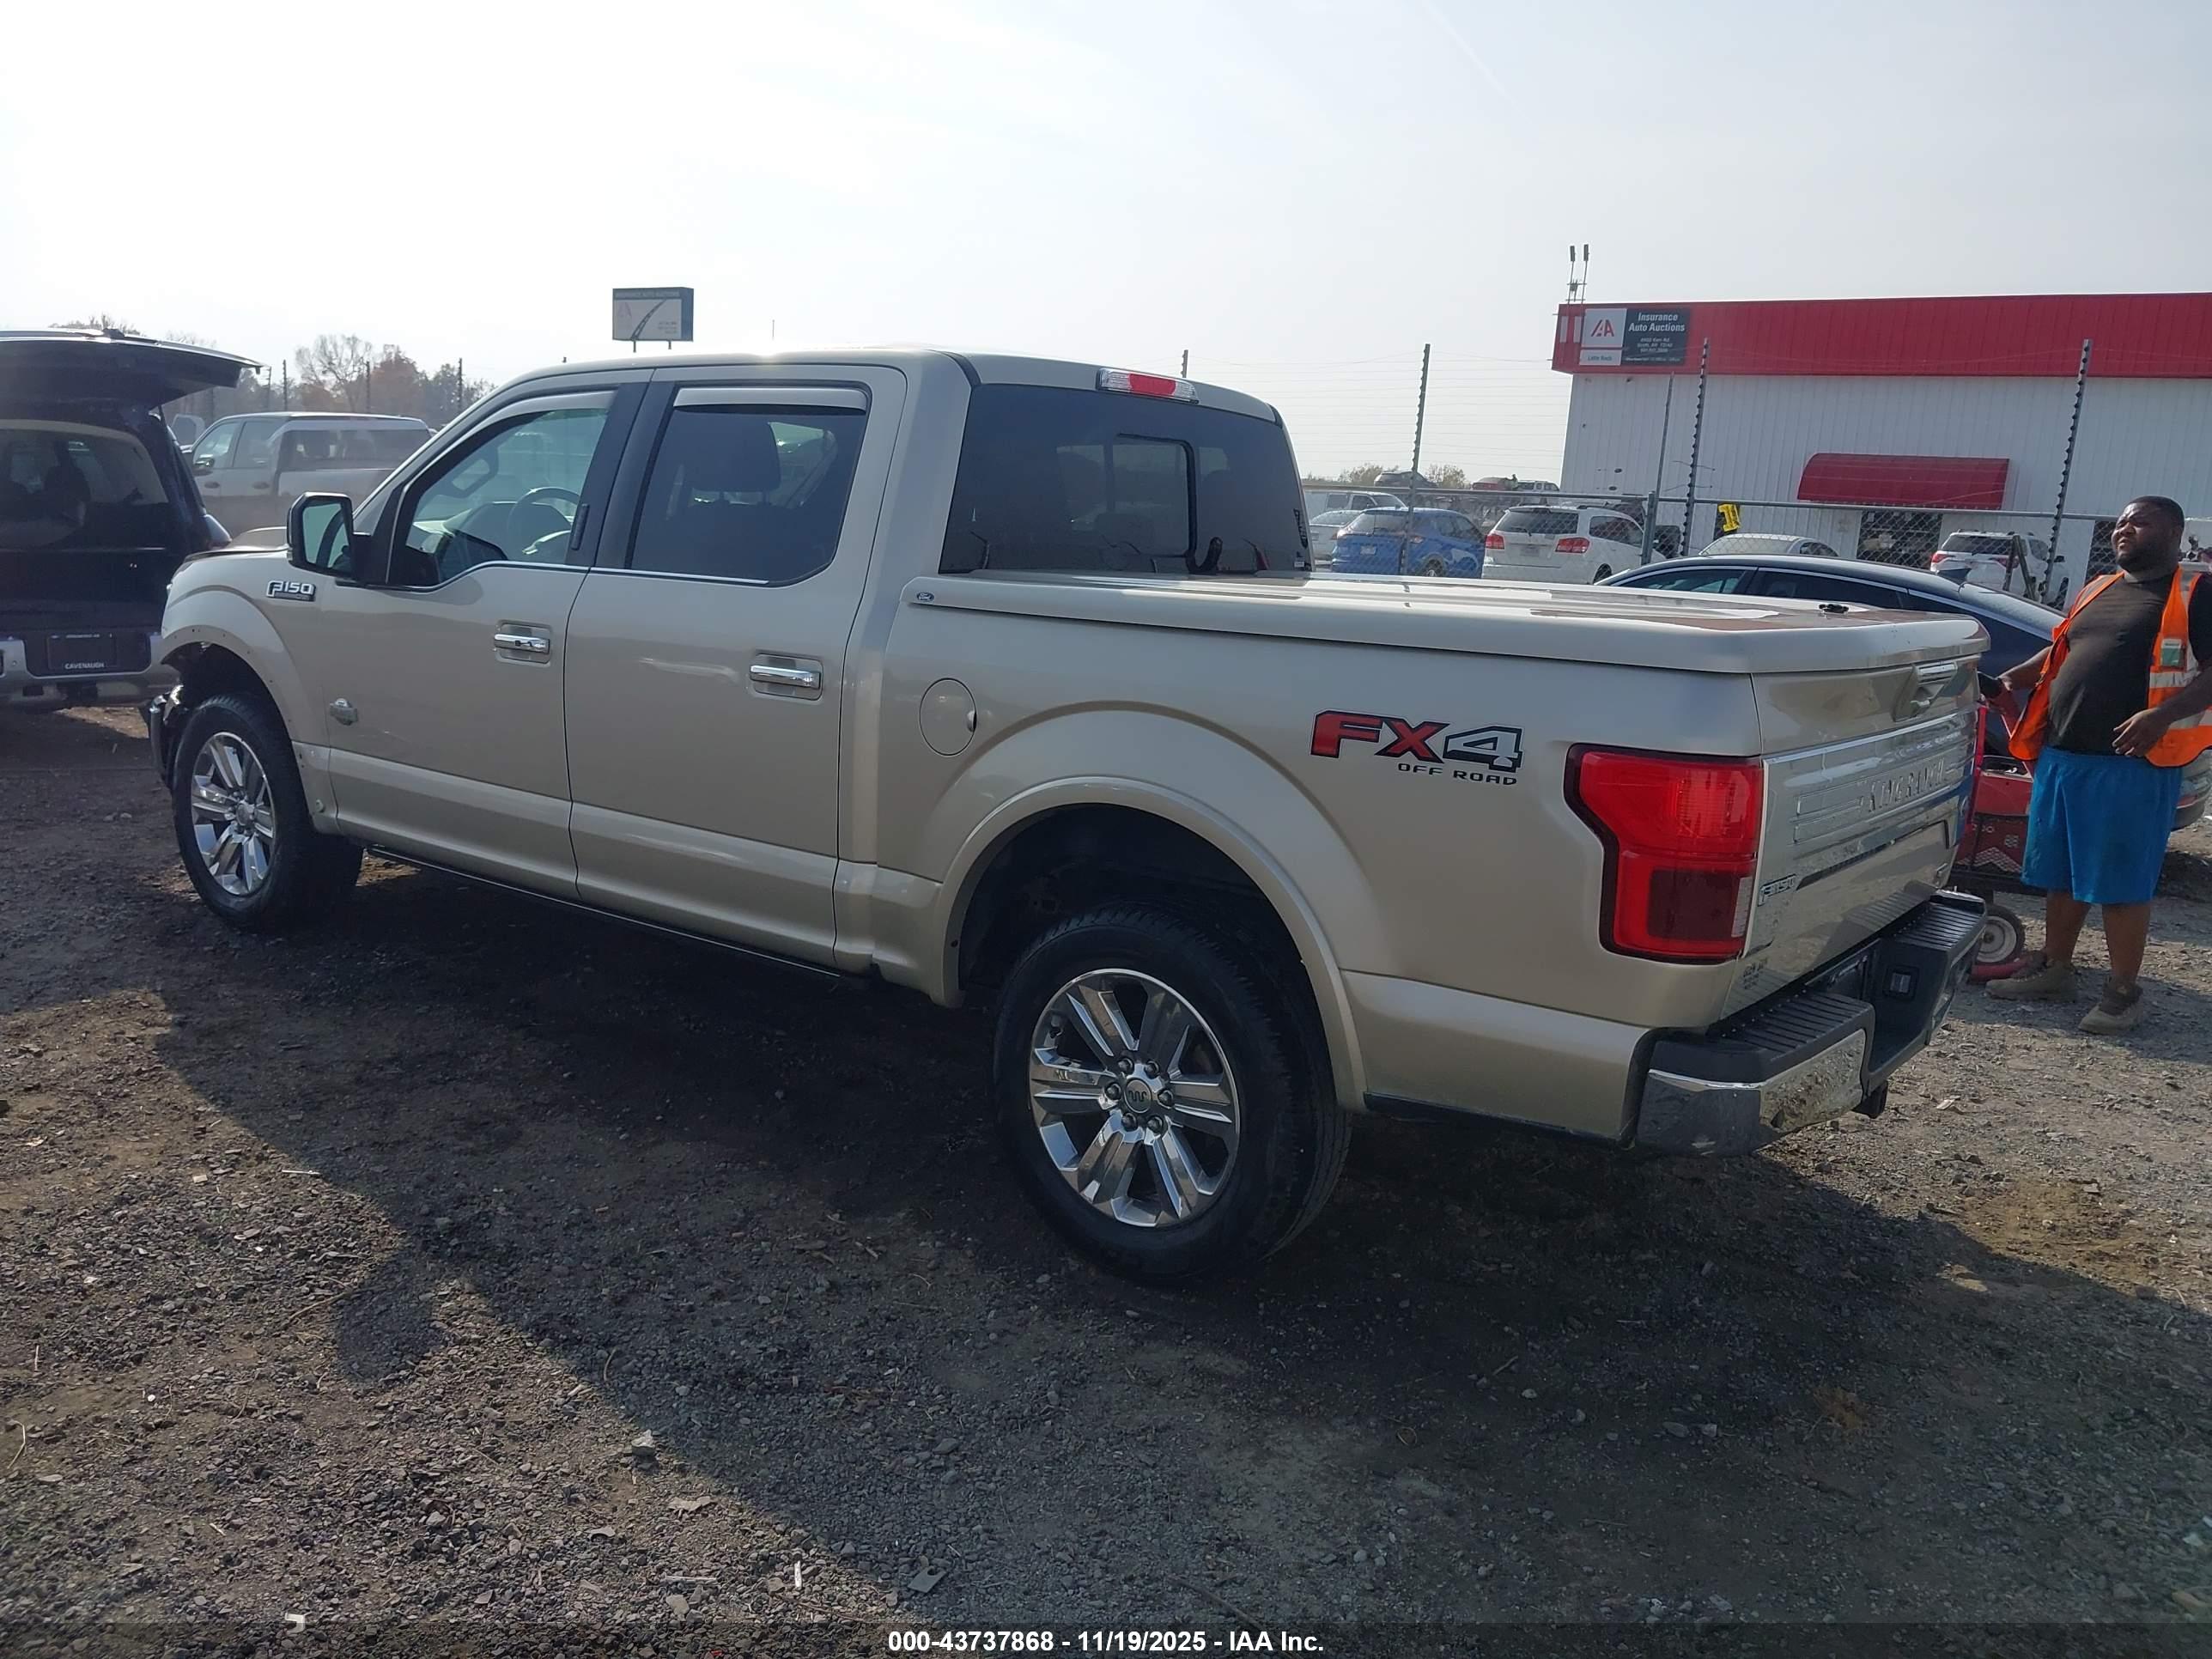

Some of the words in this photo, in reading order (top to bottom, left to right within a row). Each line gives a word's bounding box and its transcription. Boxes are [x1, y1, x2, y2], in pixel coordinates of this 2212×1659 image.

[1638, 313, 1678, 321] Insurance
[1628, 322, 1648, 331] Auto
[1649, 322, 1685, 331] Auctions
[1310, 709, 1523, 773] FX4
[1398, 763, 1443, 776] OFF
[1453, 769, 1518, 786] ROAD
